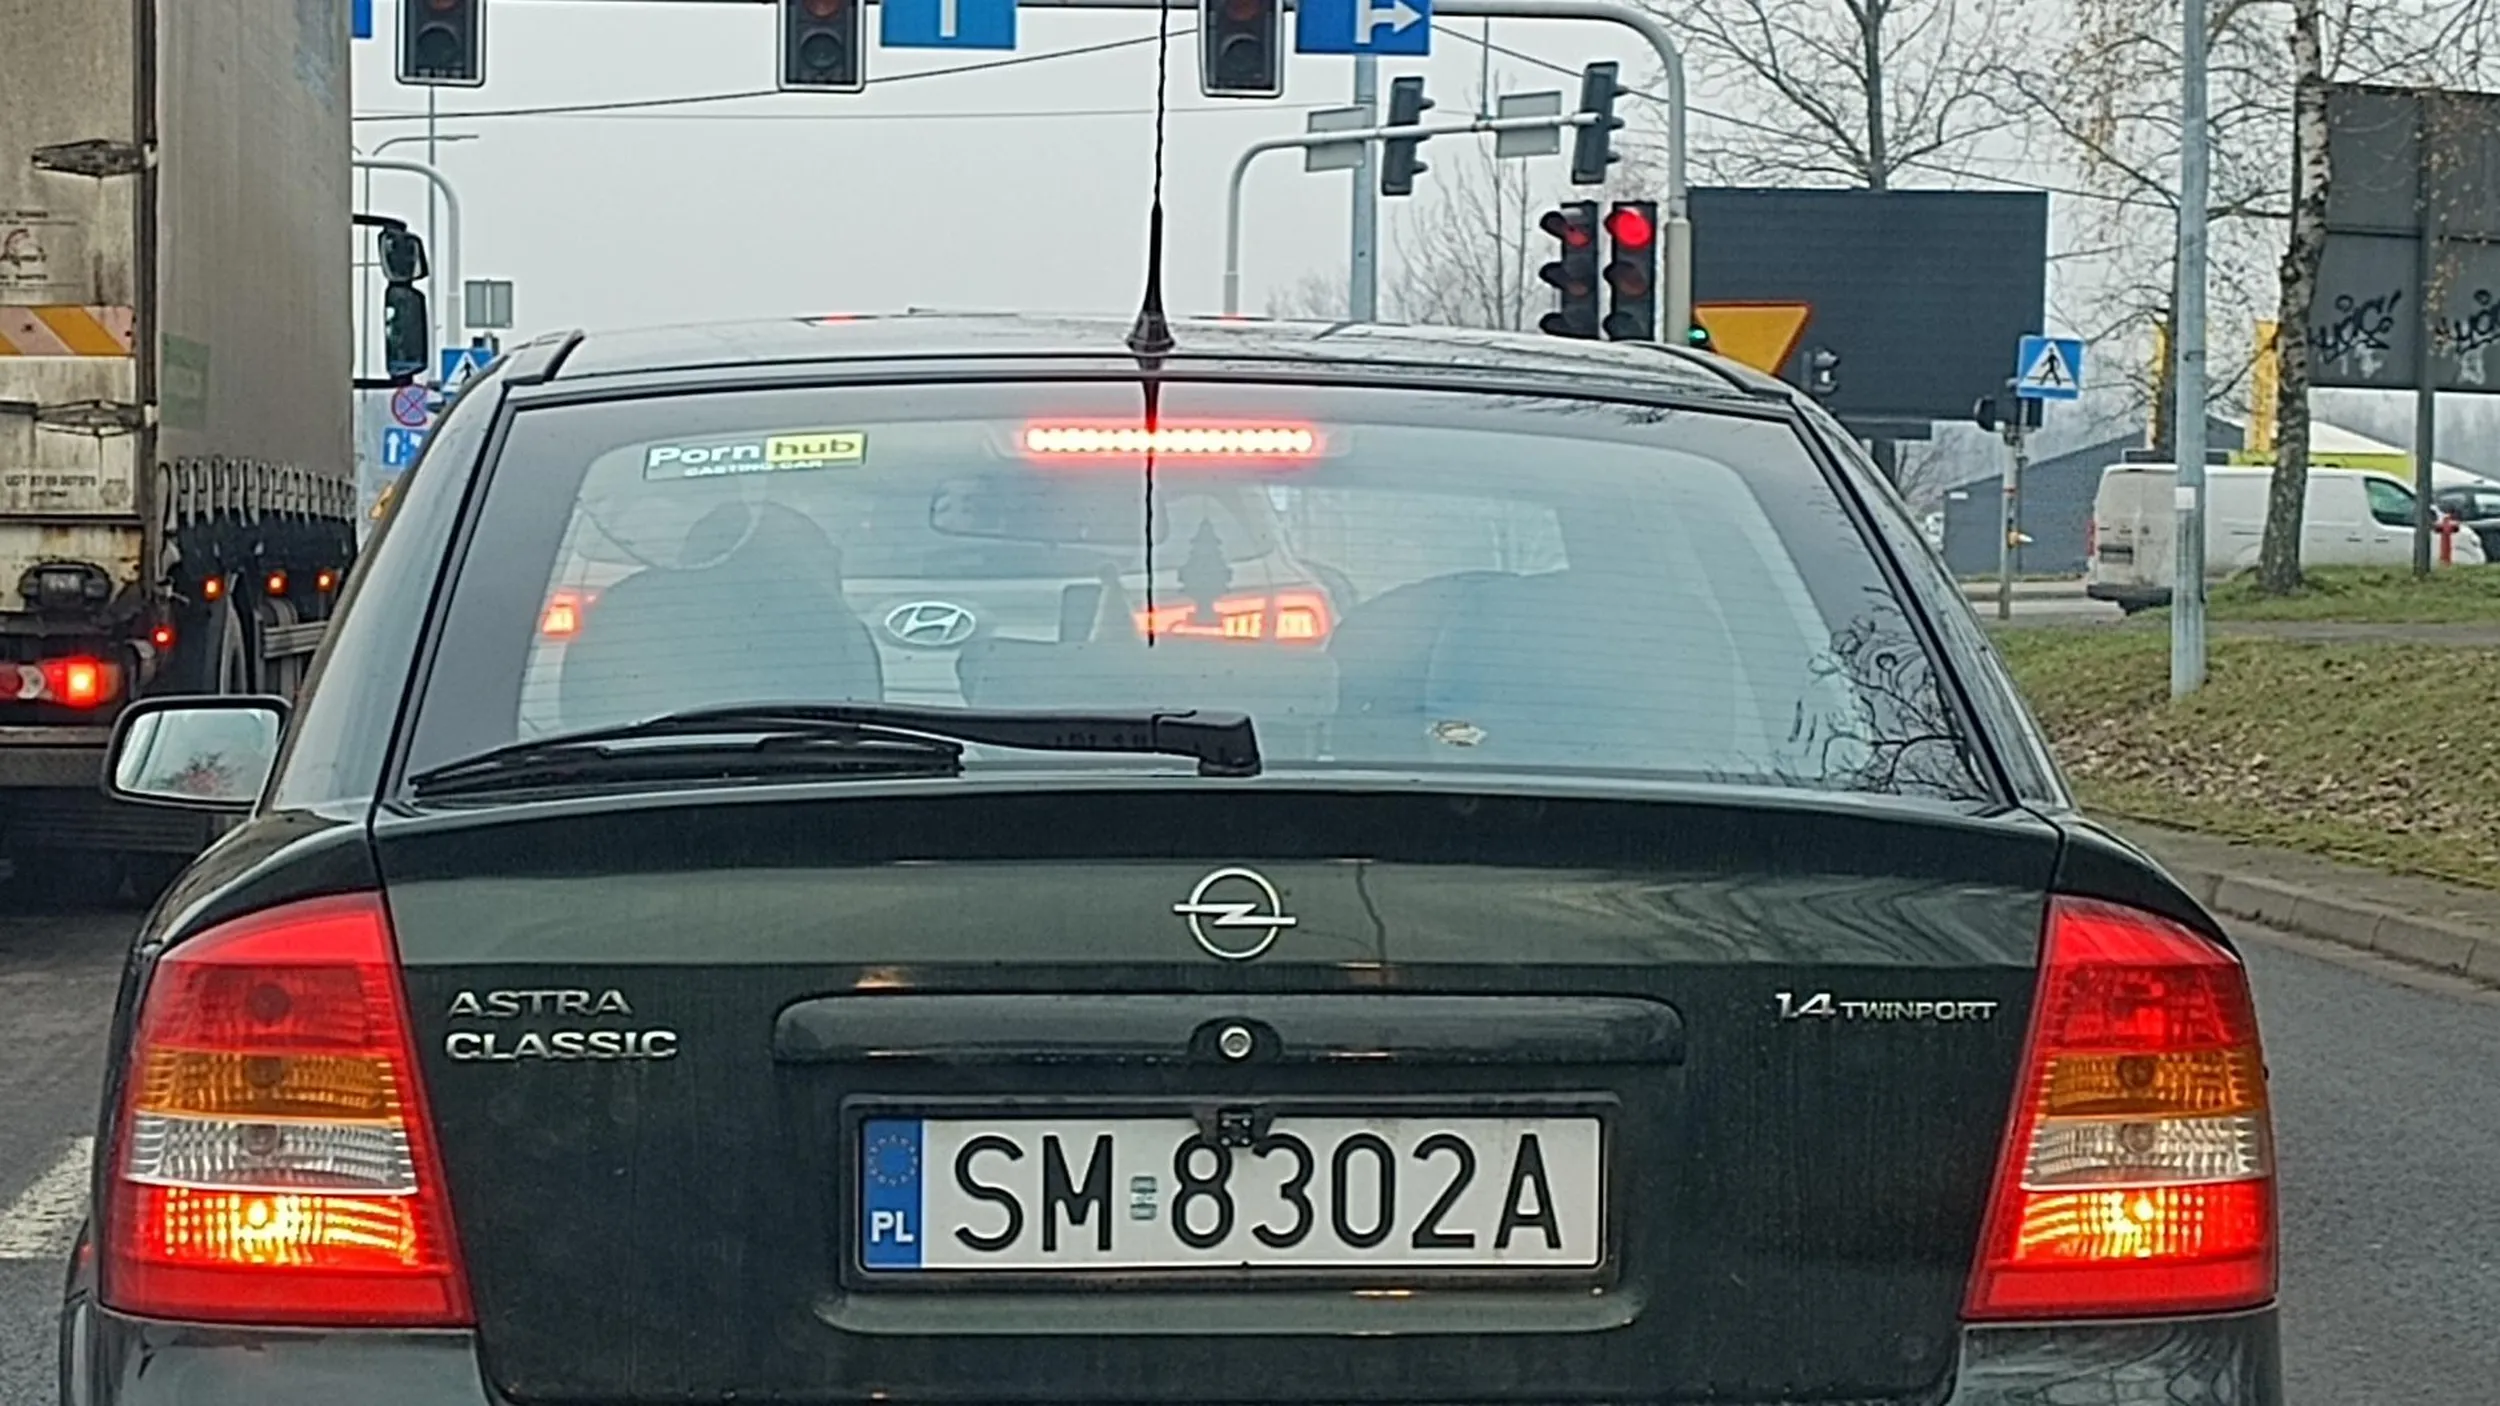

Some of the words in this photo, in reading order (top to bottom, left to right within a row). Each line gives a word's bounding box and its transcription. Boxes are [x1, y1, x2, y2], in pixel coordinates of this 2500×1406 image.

[649, 446, 760, 467] Porn
[774, 439, 856, 456] hub
[684, 462, 774, 477] CASTING
[780, 460, 824, 470] CAR
[449, 989, 634, 1017] ASTRA
[1840, 1002, 1998, 1020] TWINPORT
[446, 1031, 679, 1060] CLASSIC
[953, 1134, 1113, 1252] SM
[1170, 1133, 1563, 1250] 8302A
[870, 1212, 914, 1243] PL
